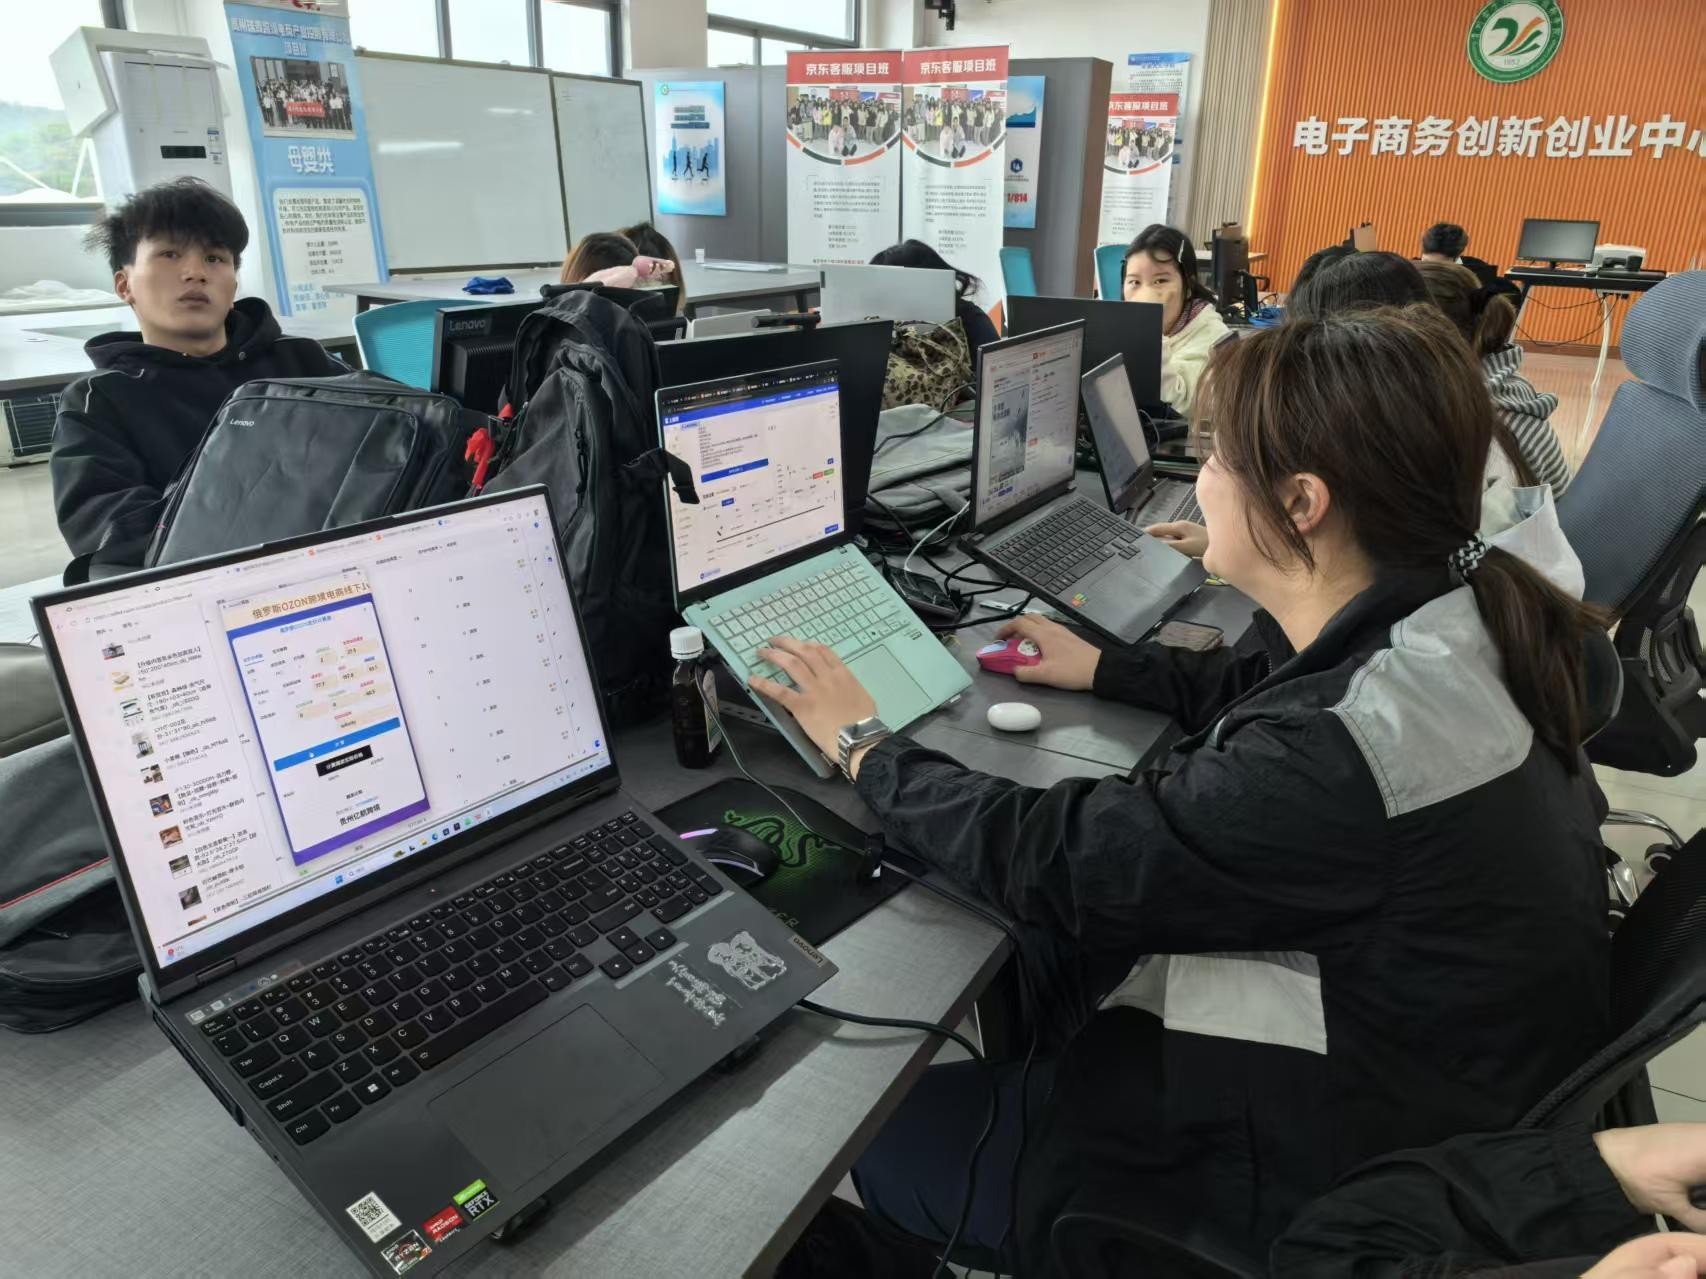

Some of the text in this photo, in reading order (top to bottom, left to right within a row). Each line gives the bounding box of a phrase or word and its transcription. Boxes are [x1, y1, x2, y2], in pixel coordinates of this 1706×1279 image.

[805, 62, 889, 76] 京东客服项目班
[920, 58, 997, 75] 京东客服项目班
[287, 144, 335, 174] 母婴类
[449, 319, 486, 331] Lenovo
[230, 418, 255, 427] Lenovo
[792, 936, 824, 965] Lenovo
[239, 1058, 253, 1068] Tab
[279, 1034, 290, 1043] Q
[309, 1016, 321, 1026] W
[338, 1002, 347, 1011] E
[367, 988, 376, 996] R
[258, 1073, 284, 1090] CapsLk
[336, 1034, 346, 1042] S
[364, 1017, 374, 1026] D
[392, 1002, 401, 1010] F
[420, 987, 430, 996] G
[276, 1099, 294, 1112] Shift
[341, 1062, 349, 1072] Z
[398, 1029, 407, 1037] C
[501, 969, 512, 978] M
[295, 1123, 309, 1134] Ctrl
[330, 1104, 341, 1113] Fn
[464, 1190, 489, 1209] GEFORCE
[467, 1194, 495, 1217] RTX
[432, 1214, 459, 1235] RADEON
[395, 1241, 420, 1262] RYZEN
